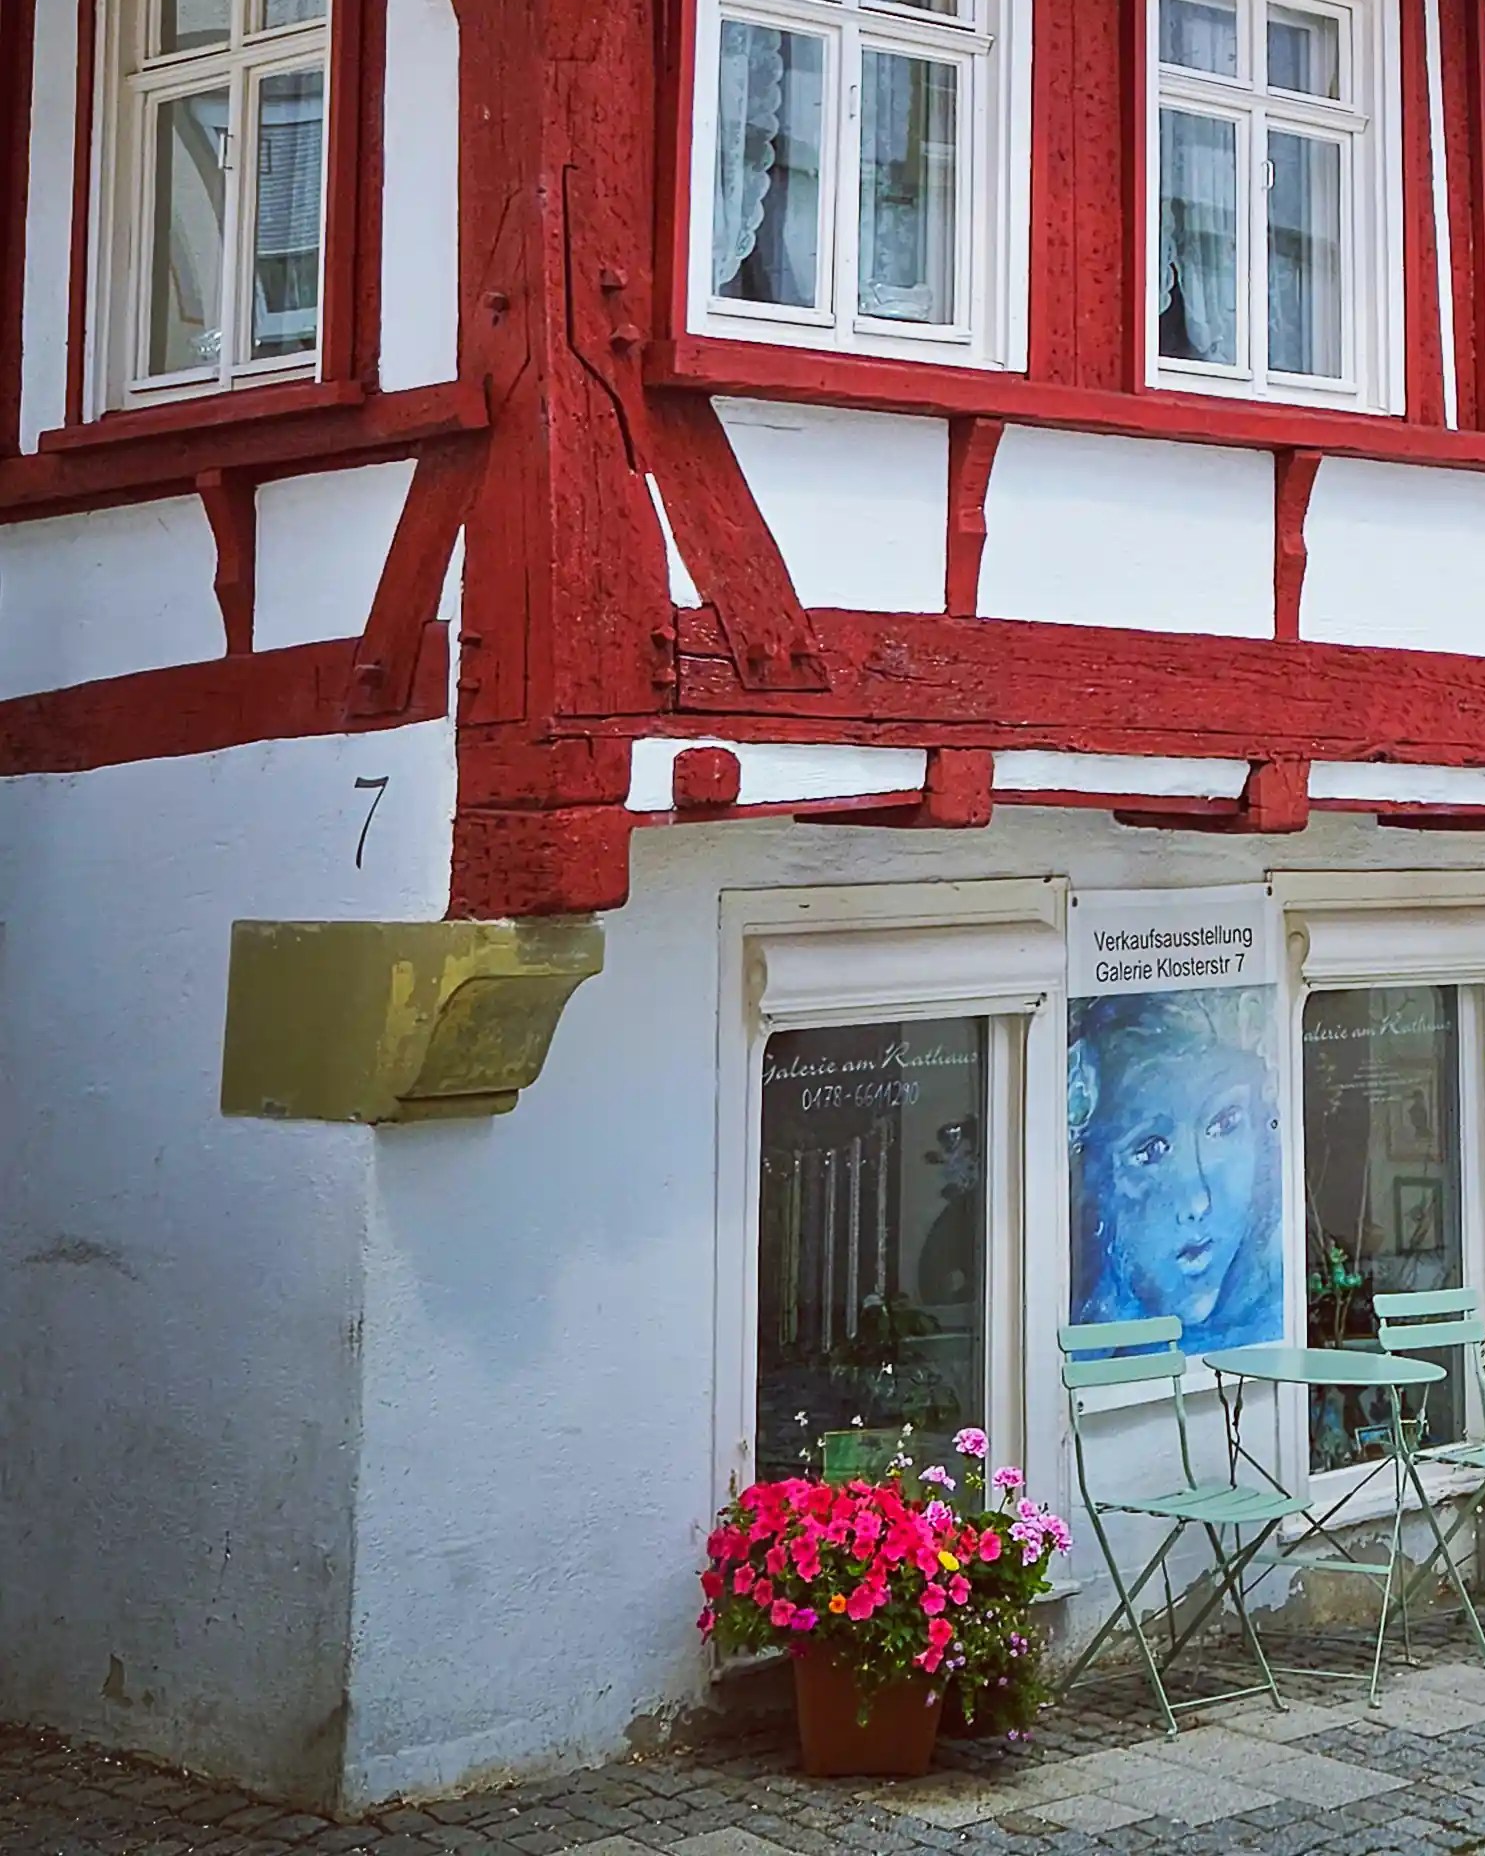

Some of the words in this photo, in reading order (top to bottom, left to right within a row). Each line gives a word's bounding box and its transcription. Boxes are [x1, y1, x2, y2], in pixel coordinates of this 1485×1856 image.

[354, 775, 389, 870] 7
[1093, 924, 1253, 952] Verkaufsausstellung
[1096, 959, 1153, 983] Galerie
[1156, 955, 1231, 979] Klosterstr
[1234, 952, 1246, 973] 7
[1303, 1020, 1349, 1043] alerie
[841, 1058, 876, 1073] am
[880, 1040, 979, 1069] Rathaus
